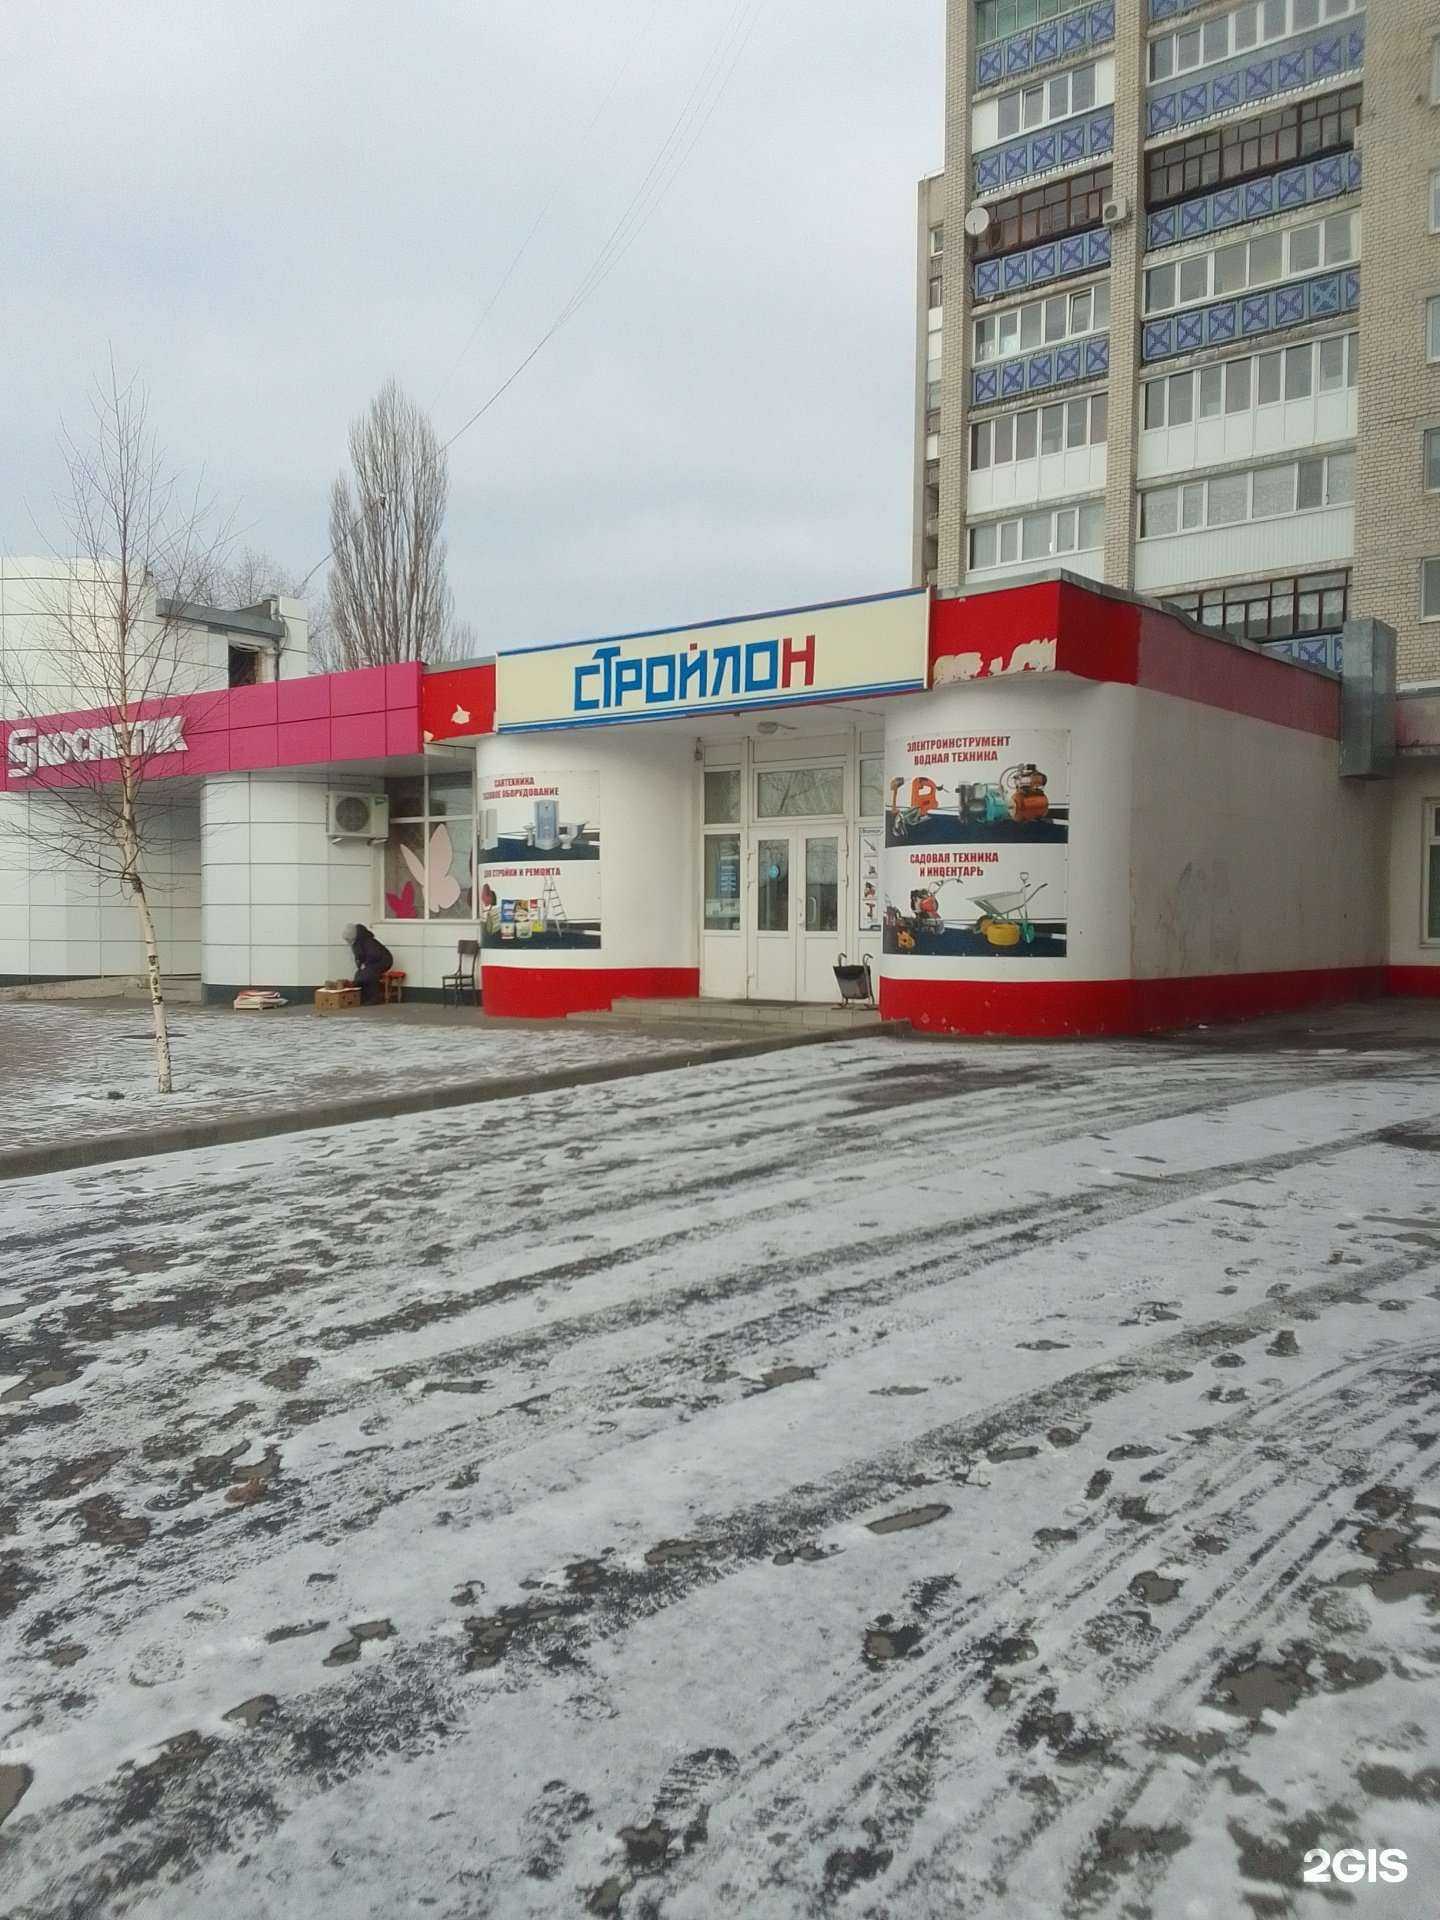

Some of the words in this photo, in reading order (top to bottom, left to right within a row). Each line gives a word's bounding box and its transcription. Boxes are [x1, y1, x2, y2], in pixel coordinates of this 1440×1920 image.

[574, 634, 816, 711] СТРОЙЛОН
[906, 736, 1011, 752] ЭЛЕКТРОИНСТРУМЕНТ
[914, 753, 949, 765] ВОДНАЯ
[951, 751, 998, 762] ТЕХНИКА
[910, 853, 950, 864] САДОВАЯ
[952, 852, 999, 862] ТЕХНИКА
[920, 867, 925, 877] И
[927, 866, 984, 877] ИНВЕНТАРЬ
